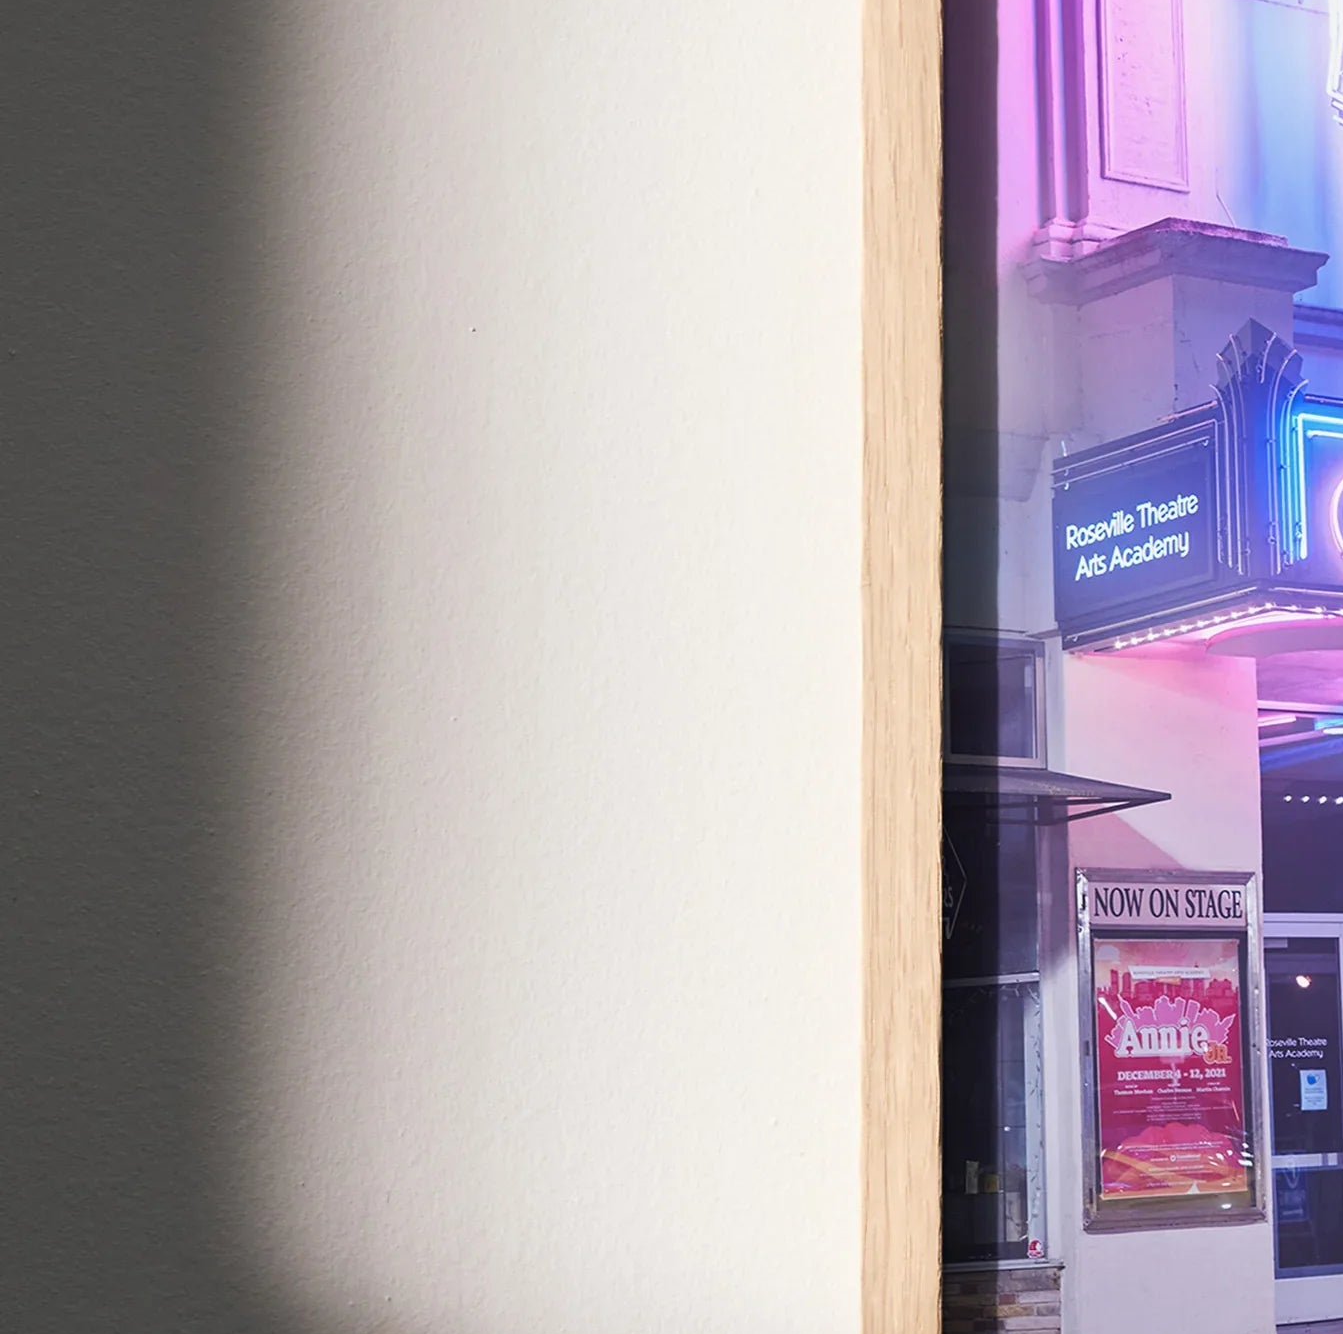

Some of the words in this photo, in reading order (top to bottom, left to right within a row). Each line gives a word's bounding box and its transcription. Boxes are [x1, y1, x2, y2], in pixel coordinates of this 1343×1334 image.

[1066, 510, 1135, 550] Roseville
[1136, 493, 1199, 529] Theatre
[1075, 554, 1107, 581] Arts
[1109, 531, 1190, 572] Academy
[1094, 887, 1144, 917] NOW
[1149, 887, 1180, 918] ON
[1185, 889, 1243, 919] STAGE
[1115, 1018, 1208, 1057] Annie
[1298, 1037, 1328, 1046] Theatre
[1269, 1049, 1284, 1058] Arts
[1285, 1049, 1323, 1059] Academy
[1117, 1069, 1173, 1081] DECEMBER
[1205, 1068, 1226, 1078] 2021
